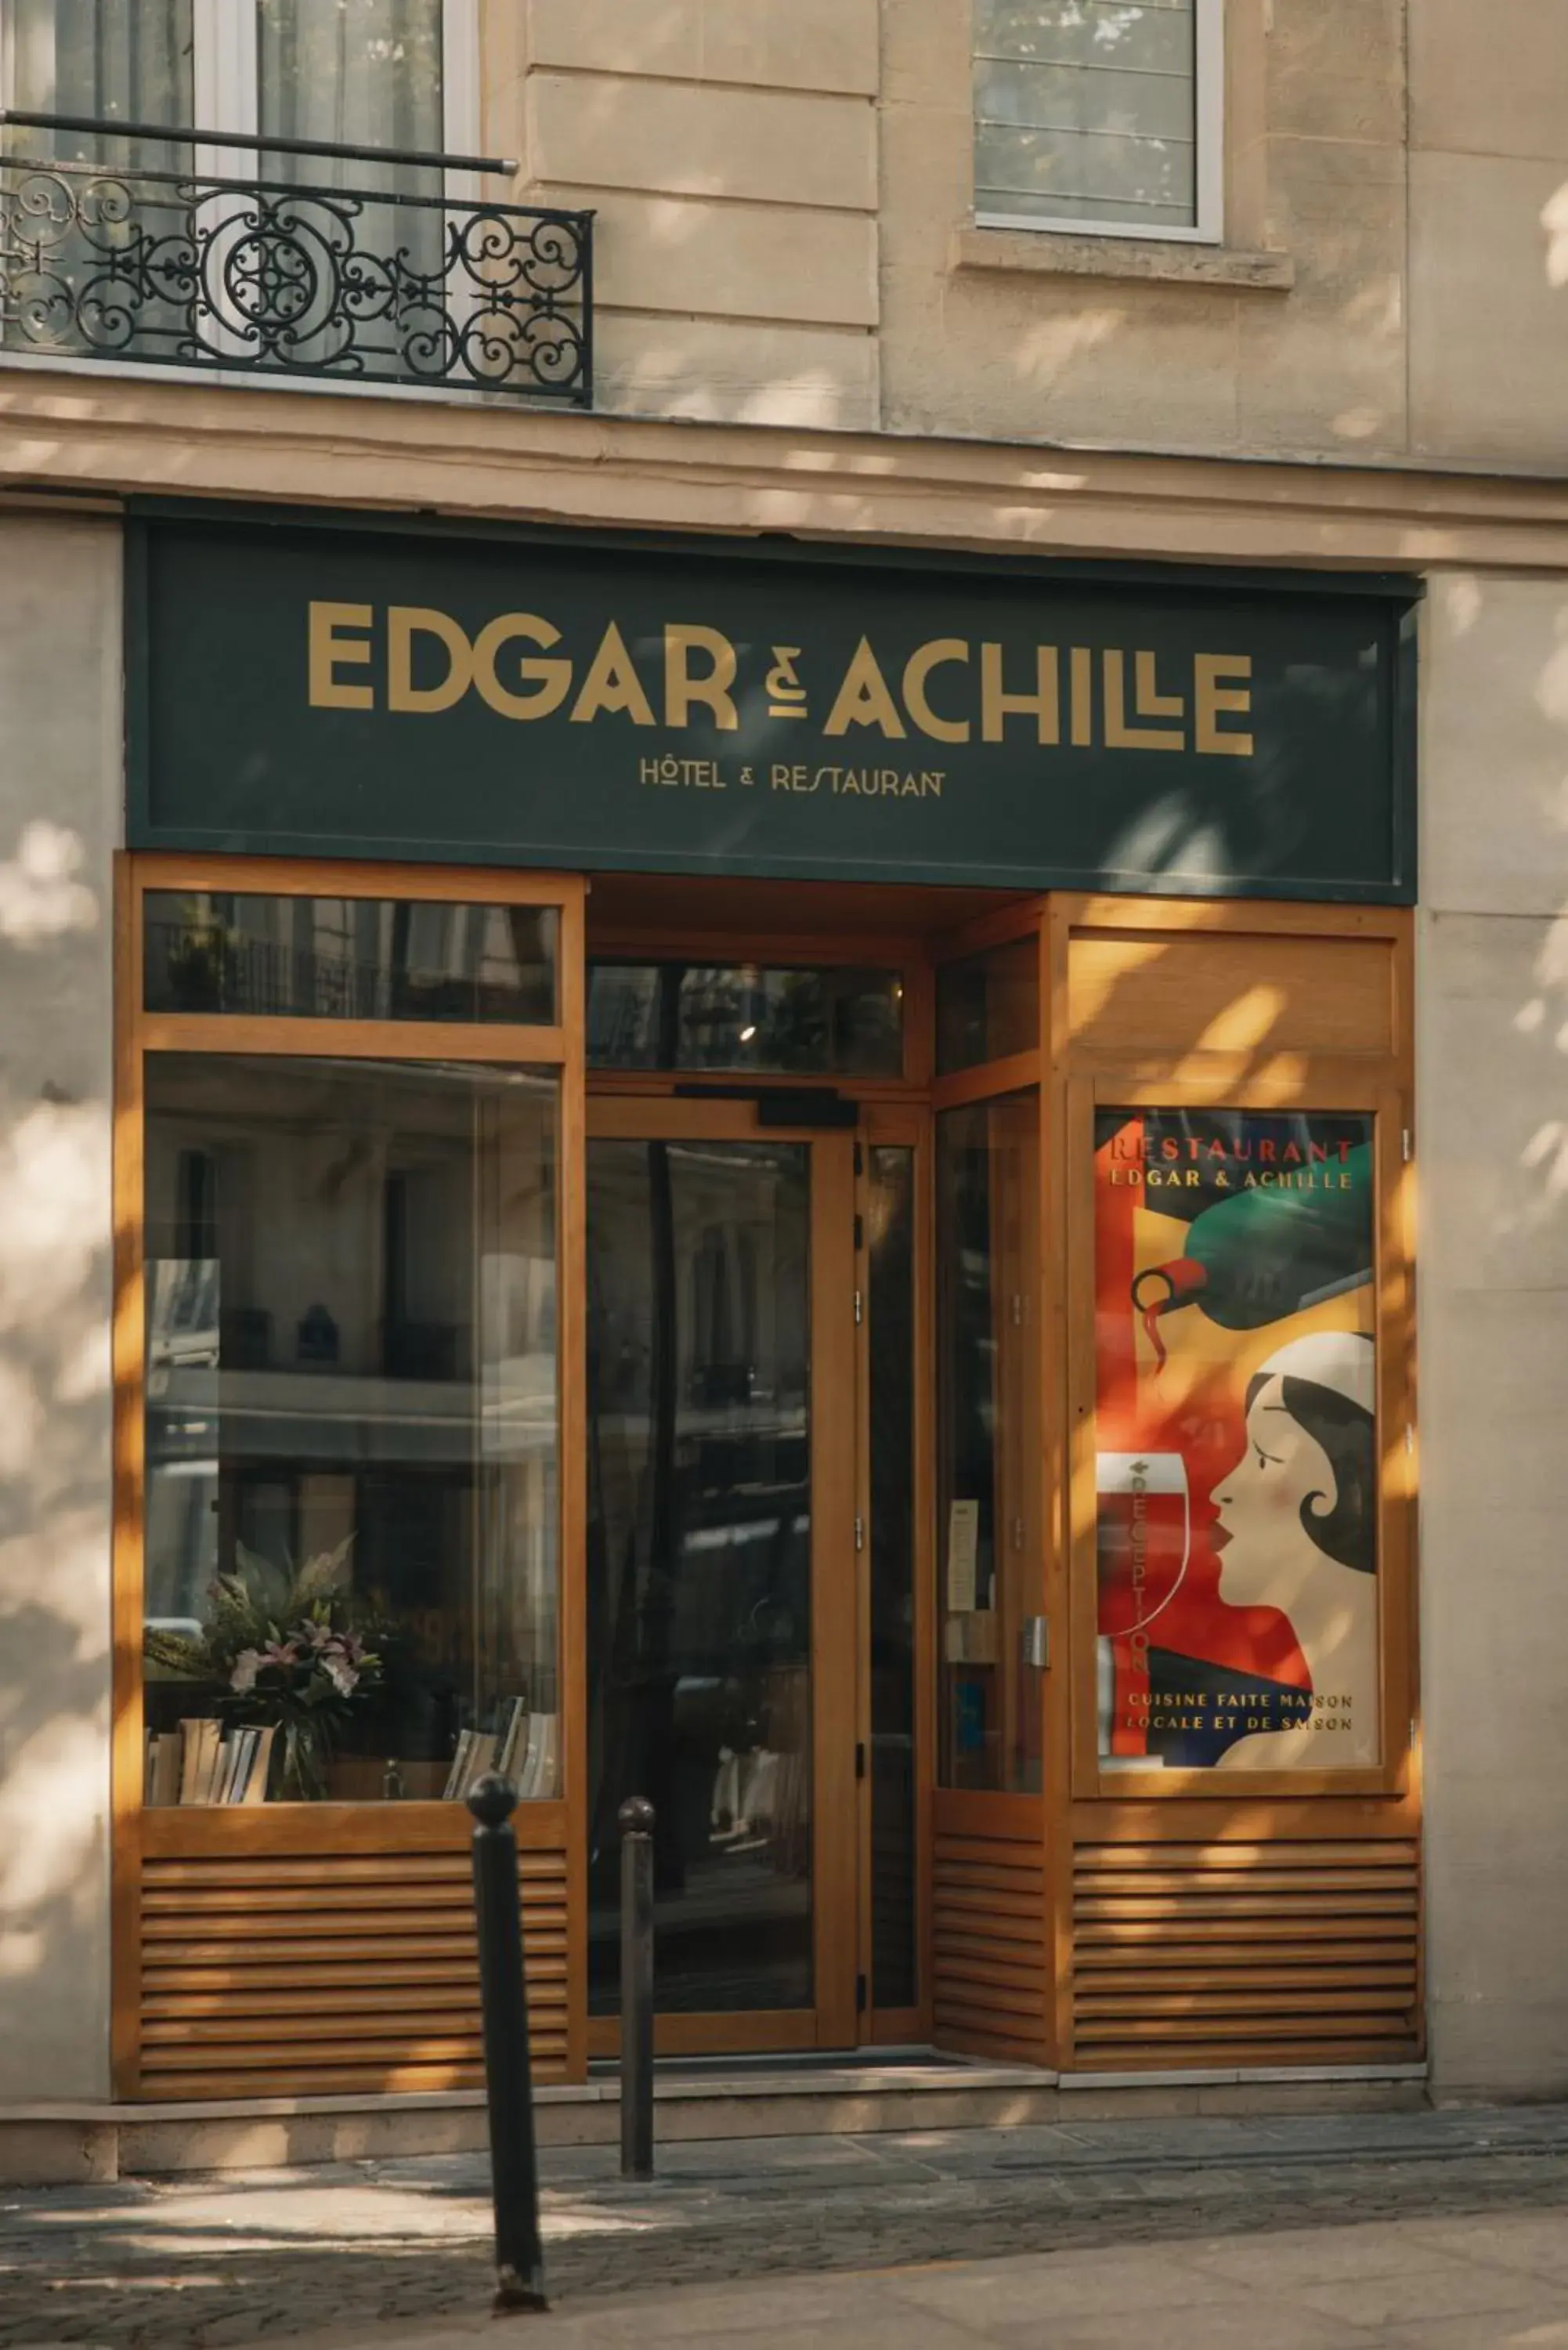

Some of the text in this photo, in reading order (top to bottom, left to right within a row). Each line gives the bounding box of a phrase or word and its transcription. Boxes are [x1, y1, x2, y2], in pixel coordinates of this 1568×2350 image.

[309, 601, 1253, 756] EDGAR & ACHILLE
[639, 754, 946, 797] HÔTEL & RESTAURANT
[1111, 1136, 1353, 1164] RESTAURANT
[1111, 1170, 1353, 1189] EDGAR & ACHILLE
[1128, 1693, 1353, 1709] CUISINE FAITE MAISON
[1126, 1715, 1353, 1731] LOCALE ET DE SAISON
